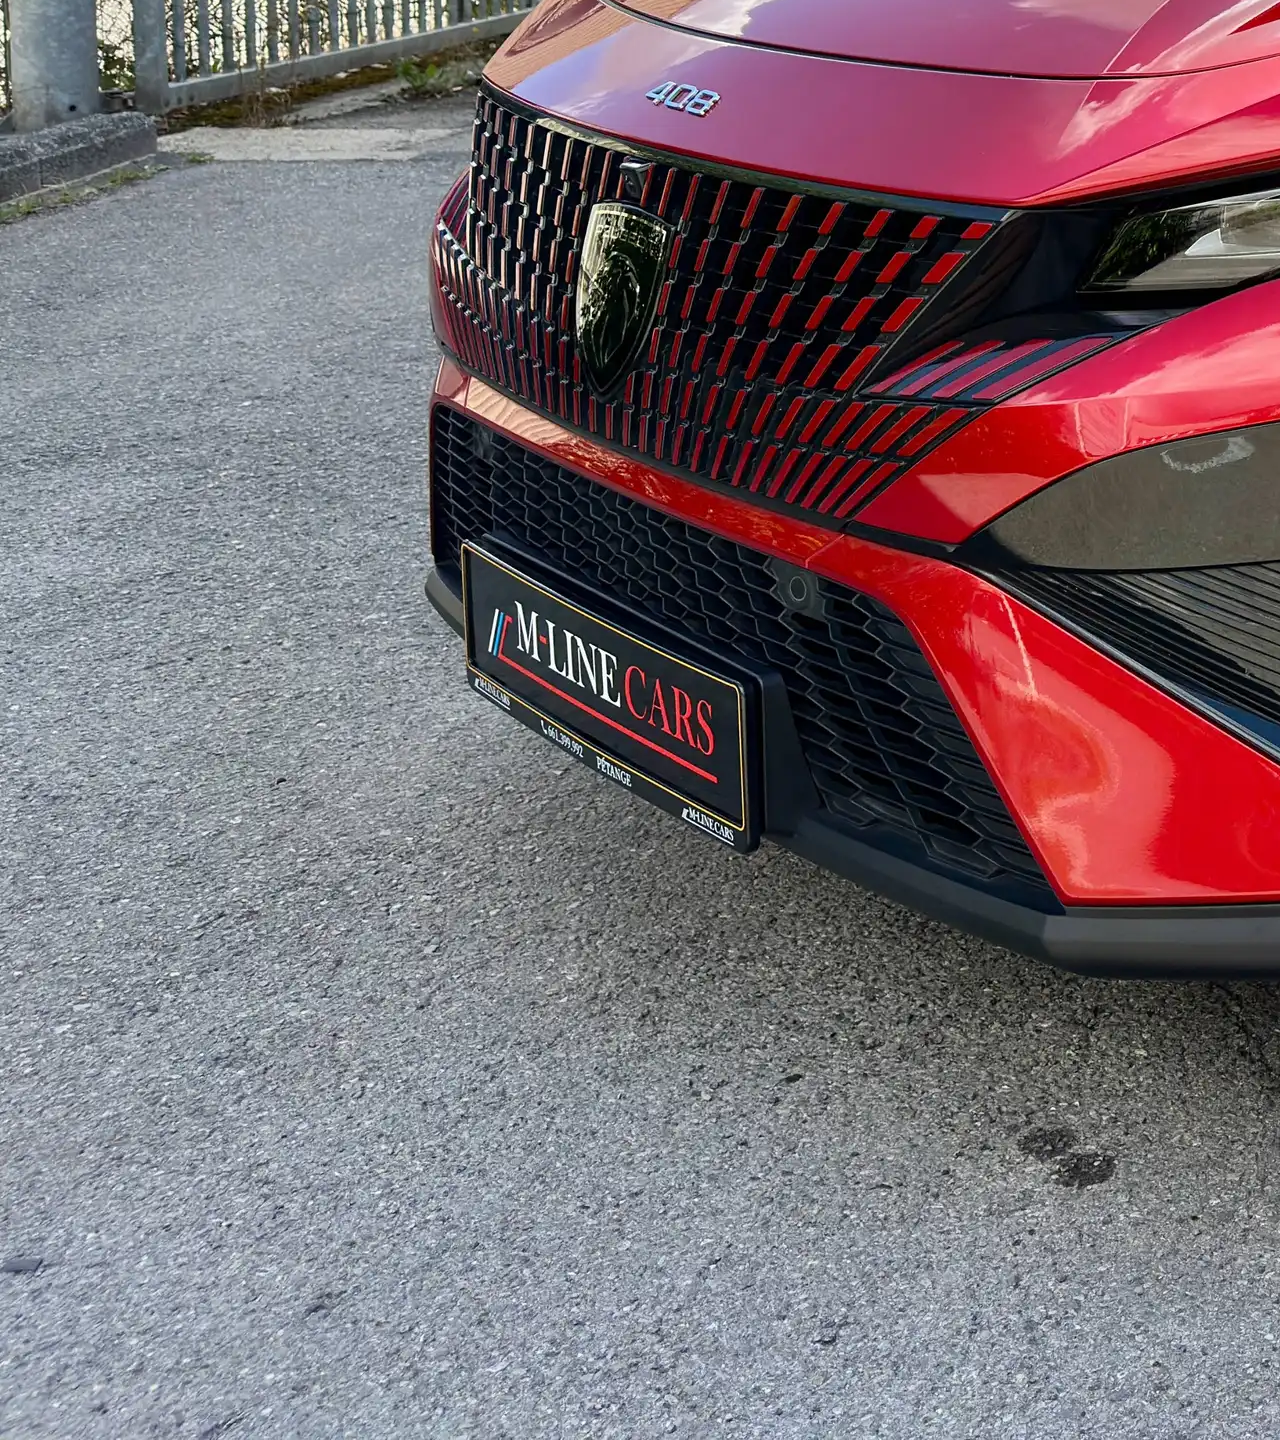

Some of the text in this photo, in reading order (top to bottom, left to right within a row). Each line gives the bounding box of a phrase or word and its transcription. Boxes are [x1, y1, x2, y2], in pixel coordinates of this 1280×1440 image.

[645, 80, 721, 117] 408
[515, 600, 714, 756] M-LINE CARS
[547, 725, 584, 758] 661.399.992
[596, 756, 632, 788] PÉTANGE
